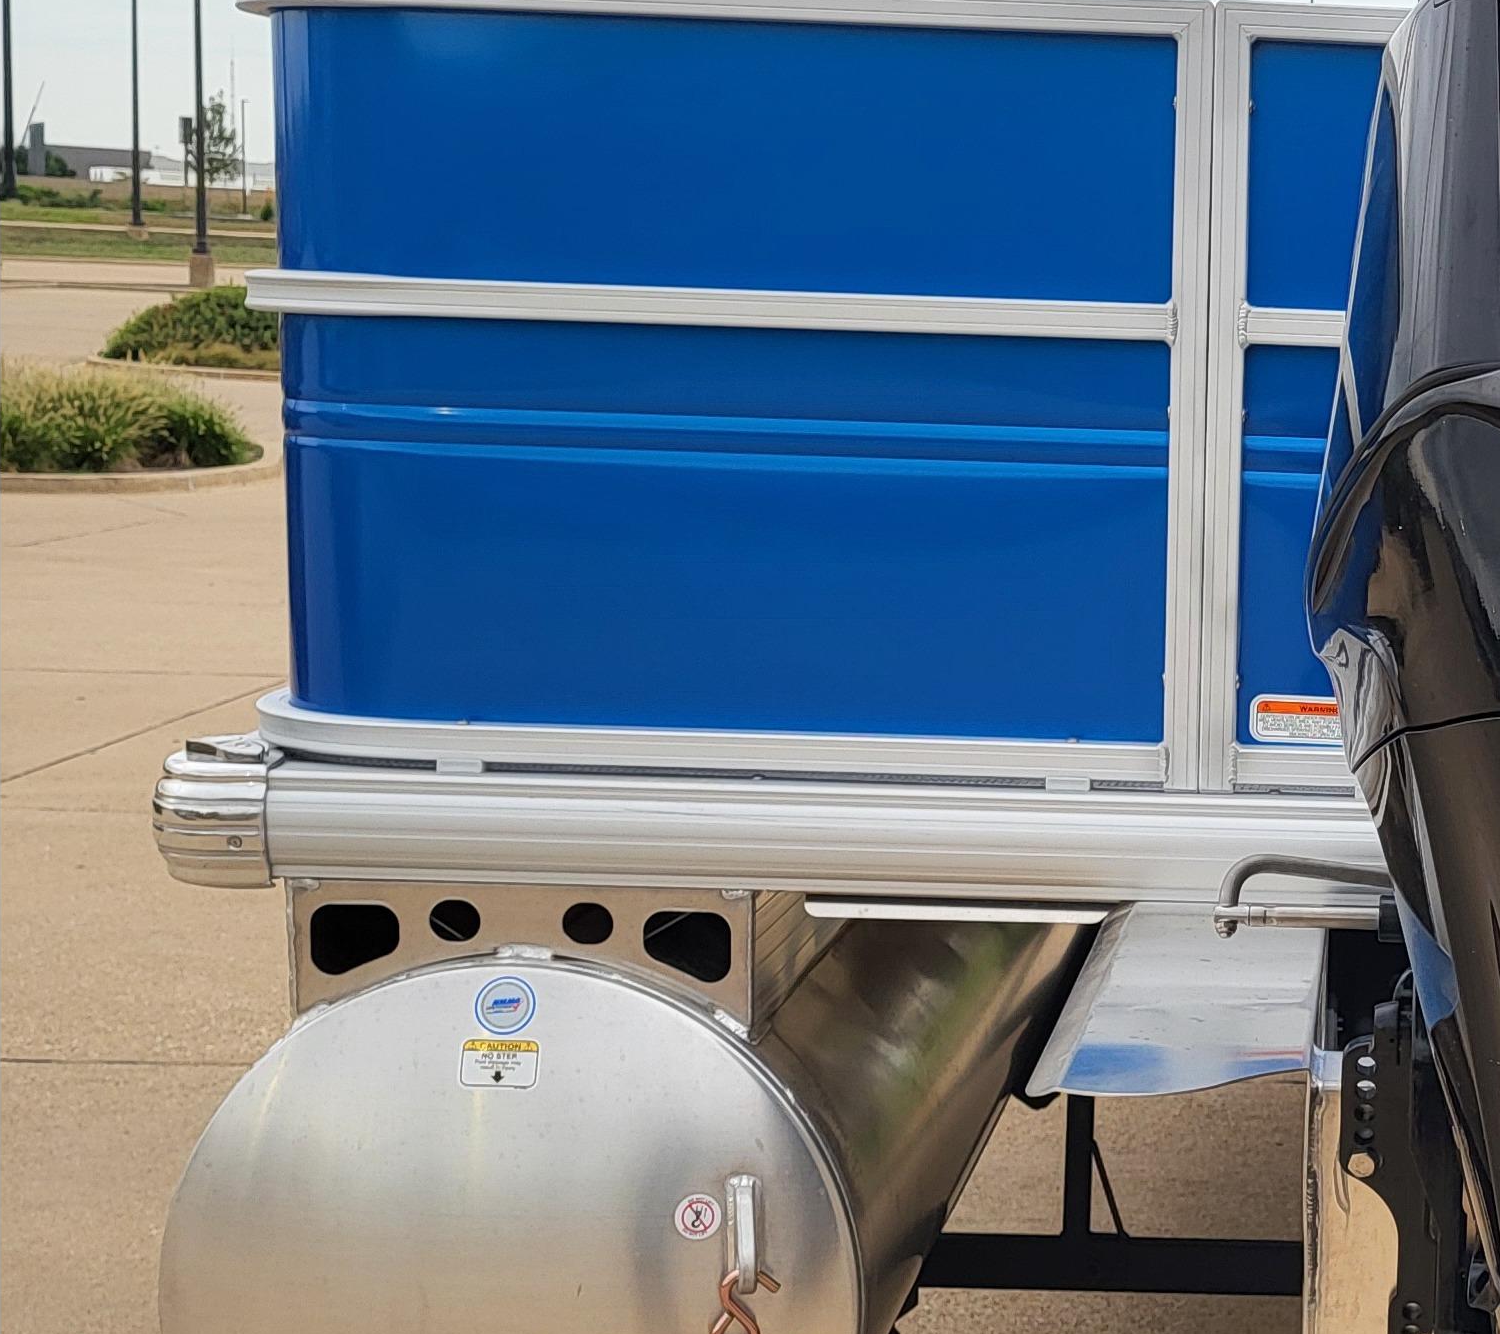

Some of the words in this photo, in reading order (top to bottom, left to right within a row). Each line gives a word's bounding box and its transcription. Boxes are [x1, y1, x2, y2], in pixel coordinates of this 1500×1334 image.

[480, 1041, 522, 1052] CAUTION
[481, 1052, 494, 1060] NO
[496, 1052, 518, 1060] STEP
